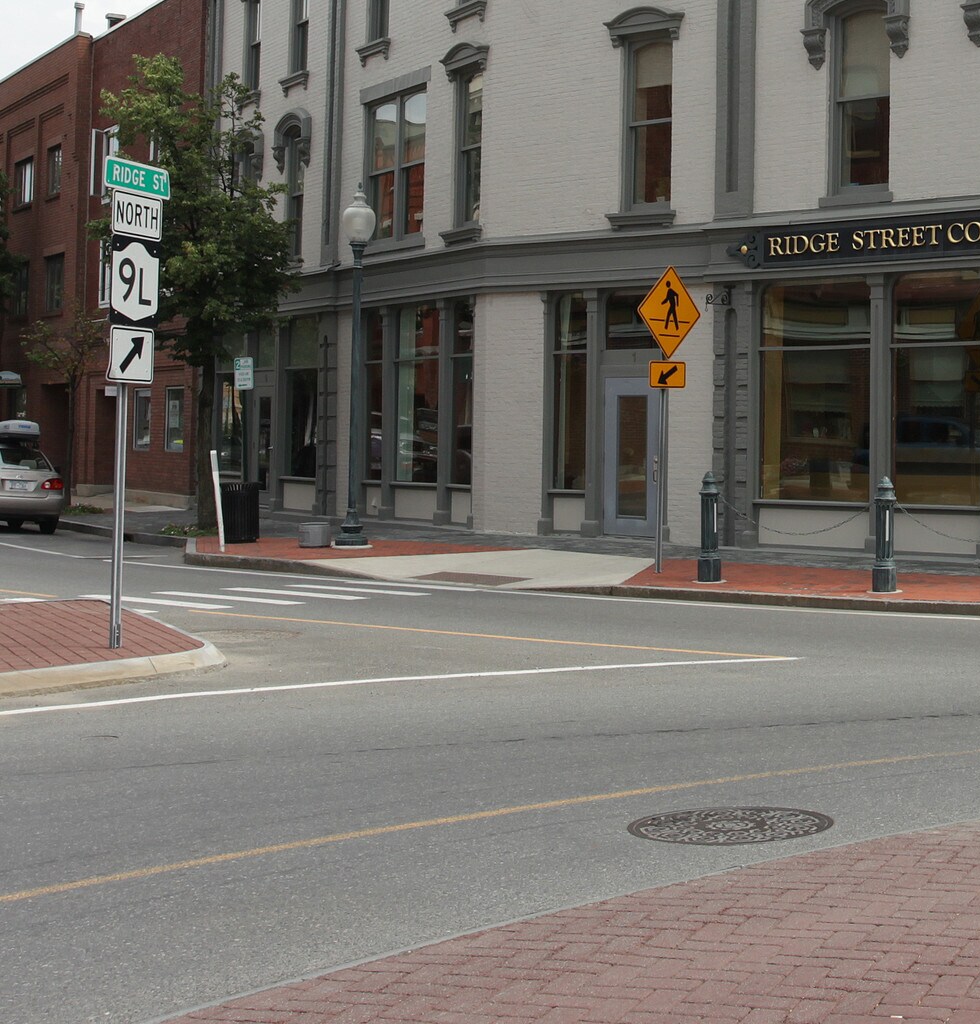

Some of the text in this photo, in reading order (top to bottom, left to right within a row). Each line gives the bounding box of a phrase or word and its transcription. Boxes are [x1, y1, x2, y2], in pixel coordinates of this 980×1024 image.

[112, 163, 166, 192] RIDGE ST
[116, 200, 159, 231] NORTH
[768, 232, 840, 257] RIDGE
[852, 224, 943, 251] STREET
[119, 257, 151, 306] 9L
